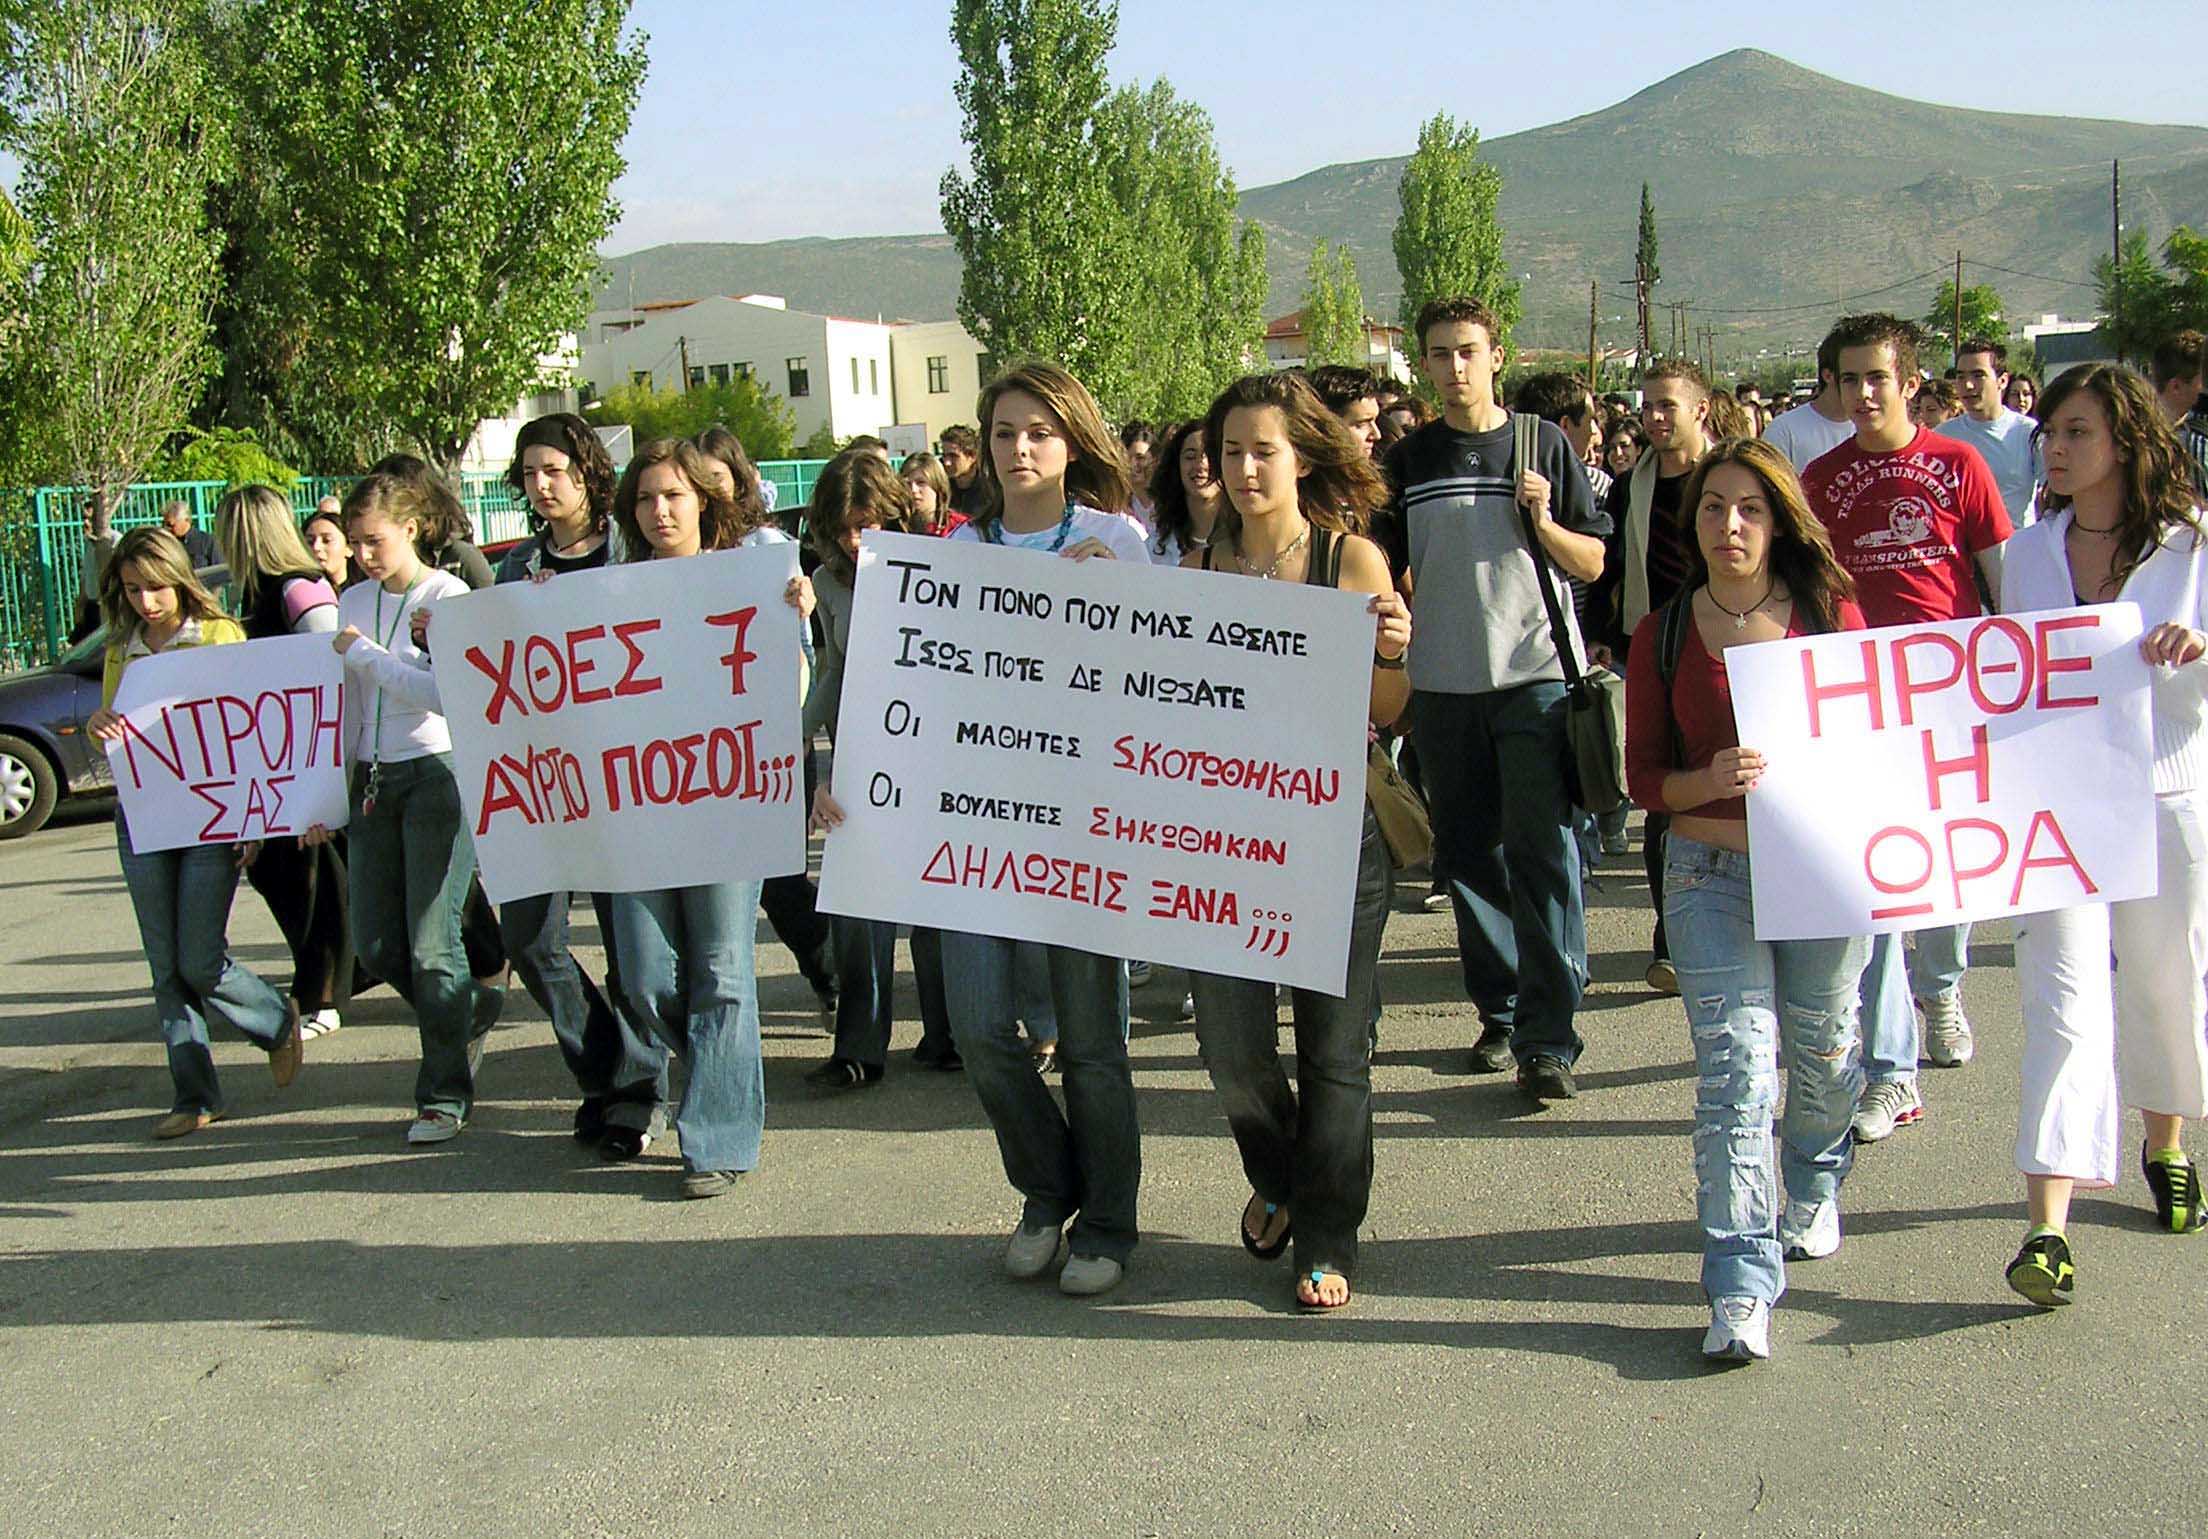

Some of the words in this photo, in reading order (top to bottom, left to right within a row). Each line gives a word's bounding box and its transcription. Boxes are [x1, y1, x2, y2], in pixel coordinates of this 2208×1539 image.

[1826, 452, 1959, 503] COLOADO
[1879, 467, 1951, 508] RUNNERS
[1845, 544, 1958, 565] TRANSPORTERS
[978, 585, 1053, 620] ΠΟΝΟ
[1065, 597, 1121, 632] ΠΟΥ
[1130, 609, 1194, 639] ΜΑΣ
[1206, 621, 1308, 657] ΔΩΣΑΤΕ
[465, 618, 663, 726] ΧΘΕΣ
[704, 605, 758, 696] 7
[894, 626, 974, 675] ΙΣΩΣ
[984, 651, 1045, 683] ΠΟΤΕ
[1067, 663, 1103, 692] ΔΕ
[1123, 671, 1246, 711] ΝΙΩΣΑΤΕ
[1800, 615, 2100, 737] ΗΡΘΕ
[120, 682, 344, 790] ΝΤΡΟΠΗ
[955, 721, 1082, 759] ΜΑΘΗΤΕΣ
[1921, 723, 1990, 810] Η
[189, 774, 297, 841] ΣΑΣ
[475, 743, 590, 836] ΑΥΡΙΟ
[939, 791, 1062, 827] ΒΟΥΛΕΥΤΕΣ
[1088, 806, 1287, 866] ΣΗΚΩΘΗΚΑΝ
[1863, 809, 2099, 920] ΩΡΑ
[920, 841, 1129, 913] ΔΗΛΩΣΕΙΣ
